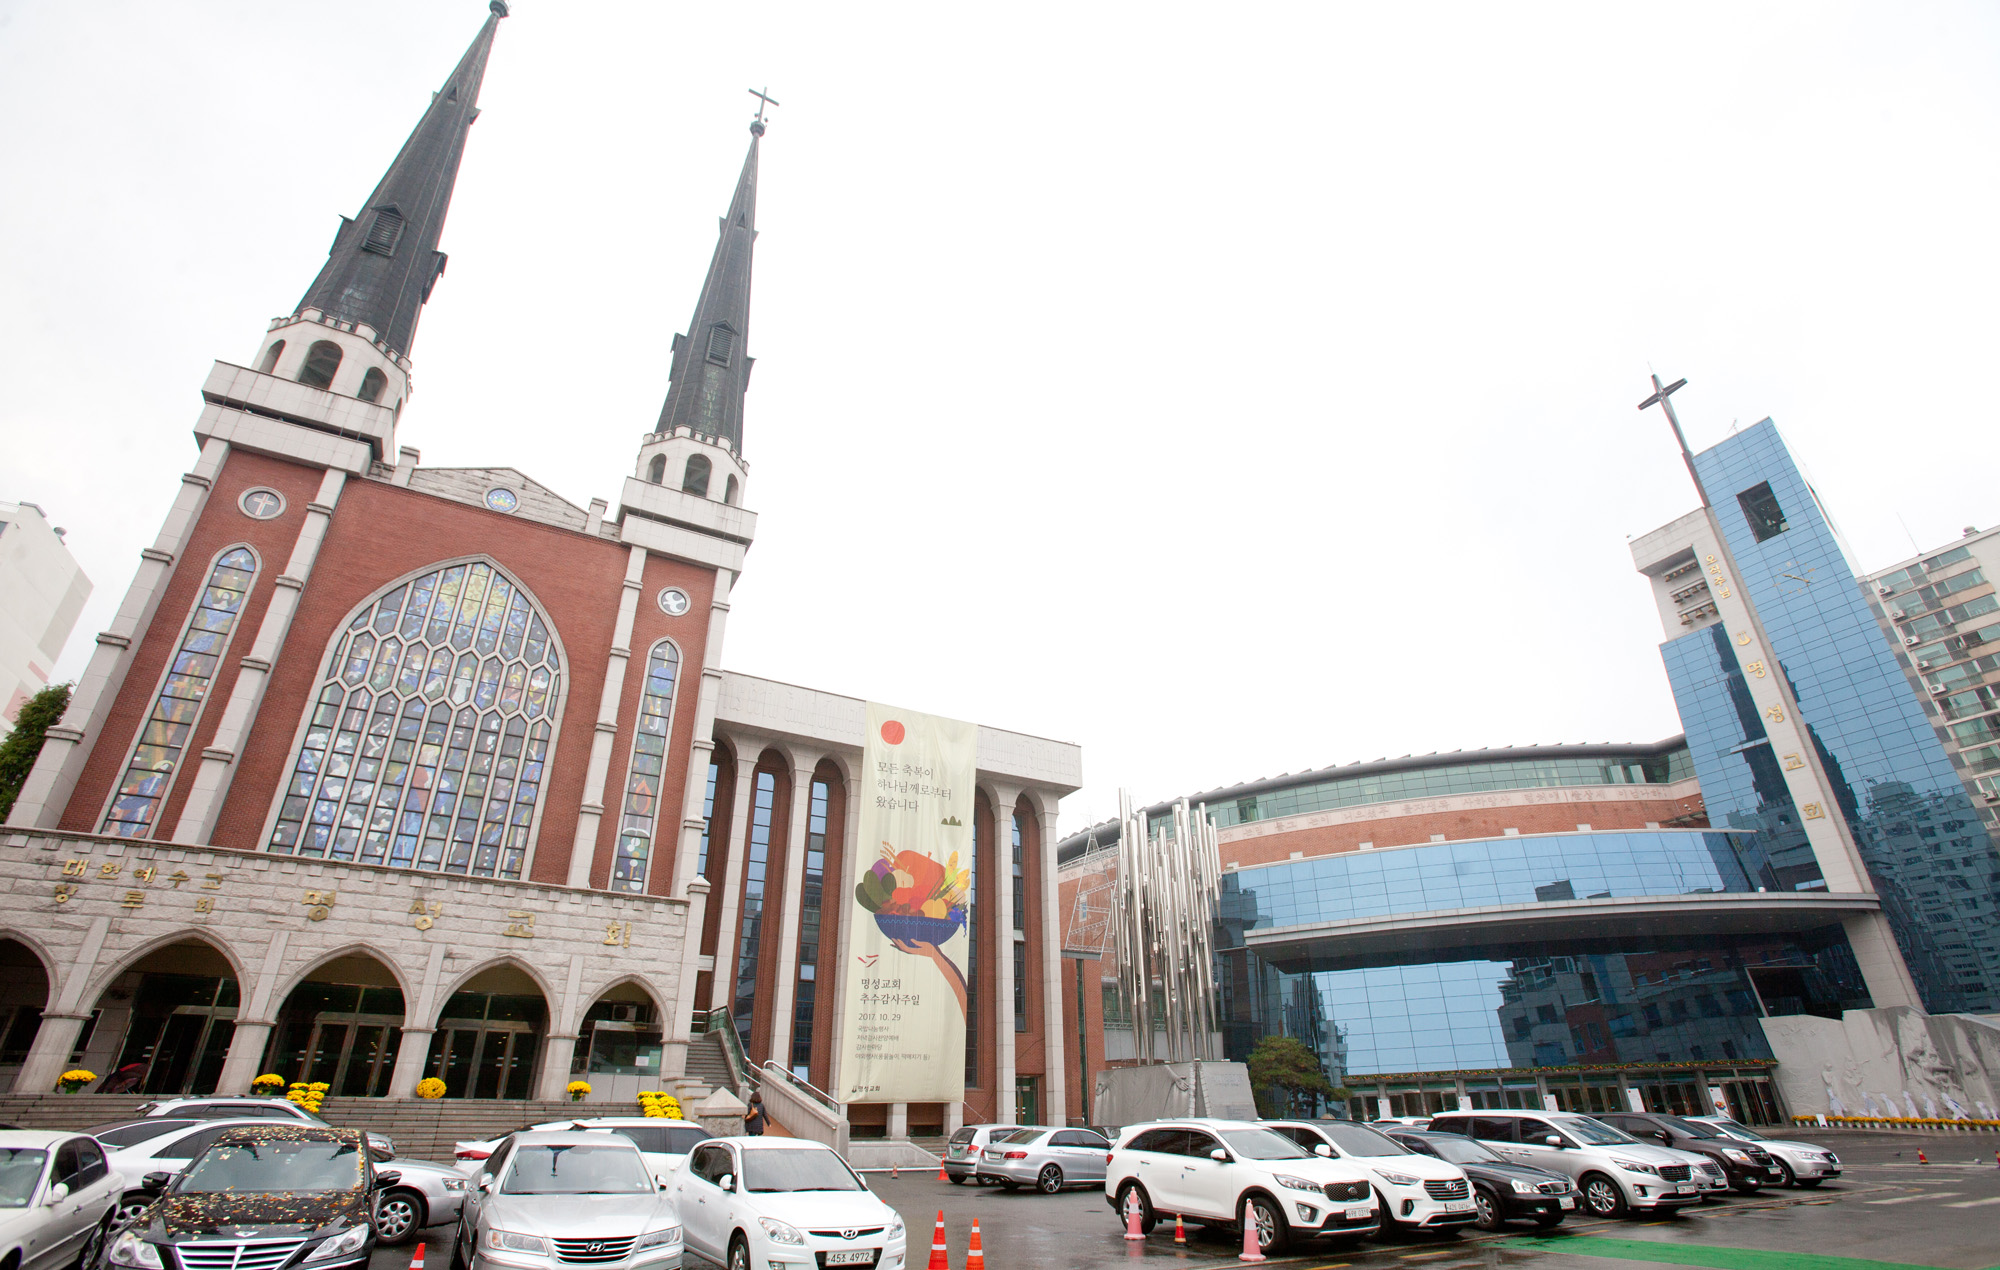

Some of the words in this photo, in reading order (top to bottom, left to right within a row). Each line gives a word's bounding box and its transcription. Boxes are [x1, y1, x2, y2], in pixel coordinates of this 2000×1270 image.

[1746, 660, 1827, 821] 명성교회
[877, 761, 899, 775] 모든
[902, 764, 934, 780] 축복이
[877, 778, 951, 801] 하나님께로부터
[875, 795, 919, 812] 왔습니다
[61, 858, 223, 890] 대한예수교
[55, 884, 216, 915] 장로회
[301, 889, 632, 949] 명성교회
[861, 978, 901, 990] 명성교회
[860, 992, 920, 1006] 추수감사주일
[891, 1013, 901, 1021] 29
[849, 1252, 870, 1262] 4972
